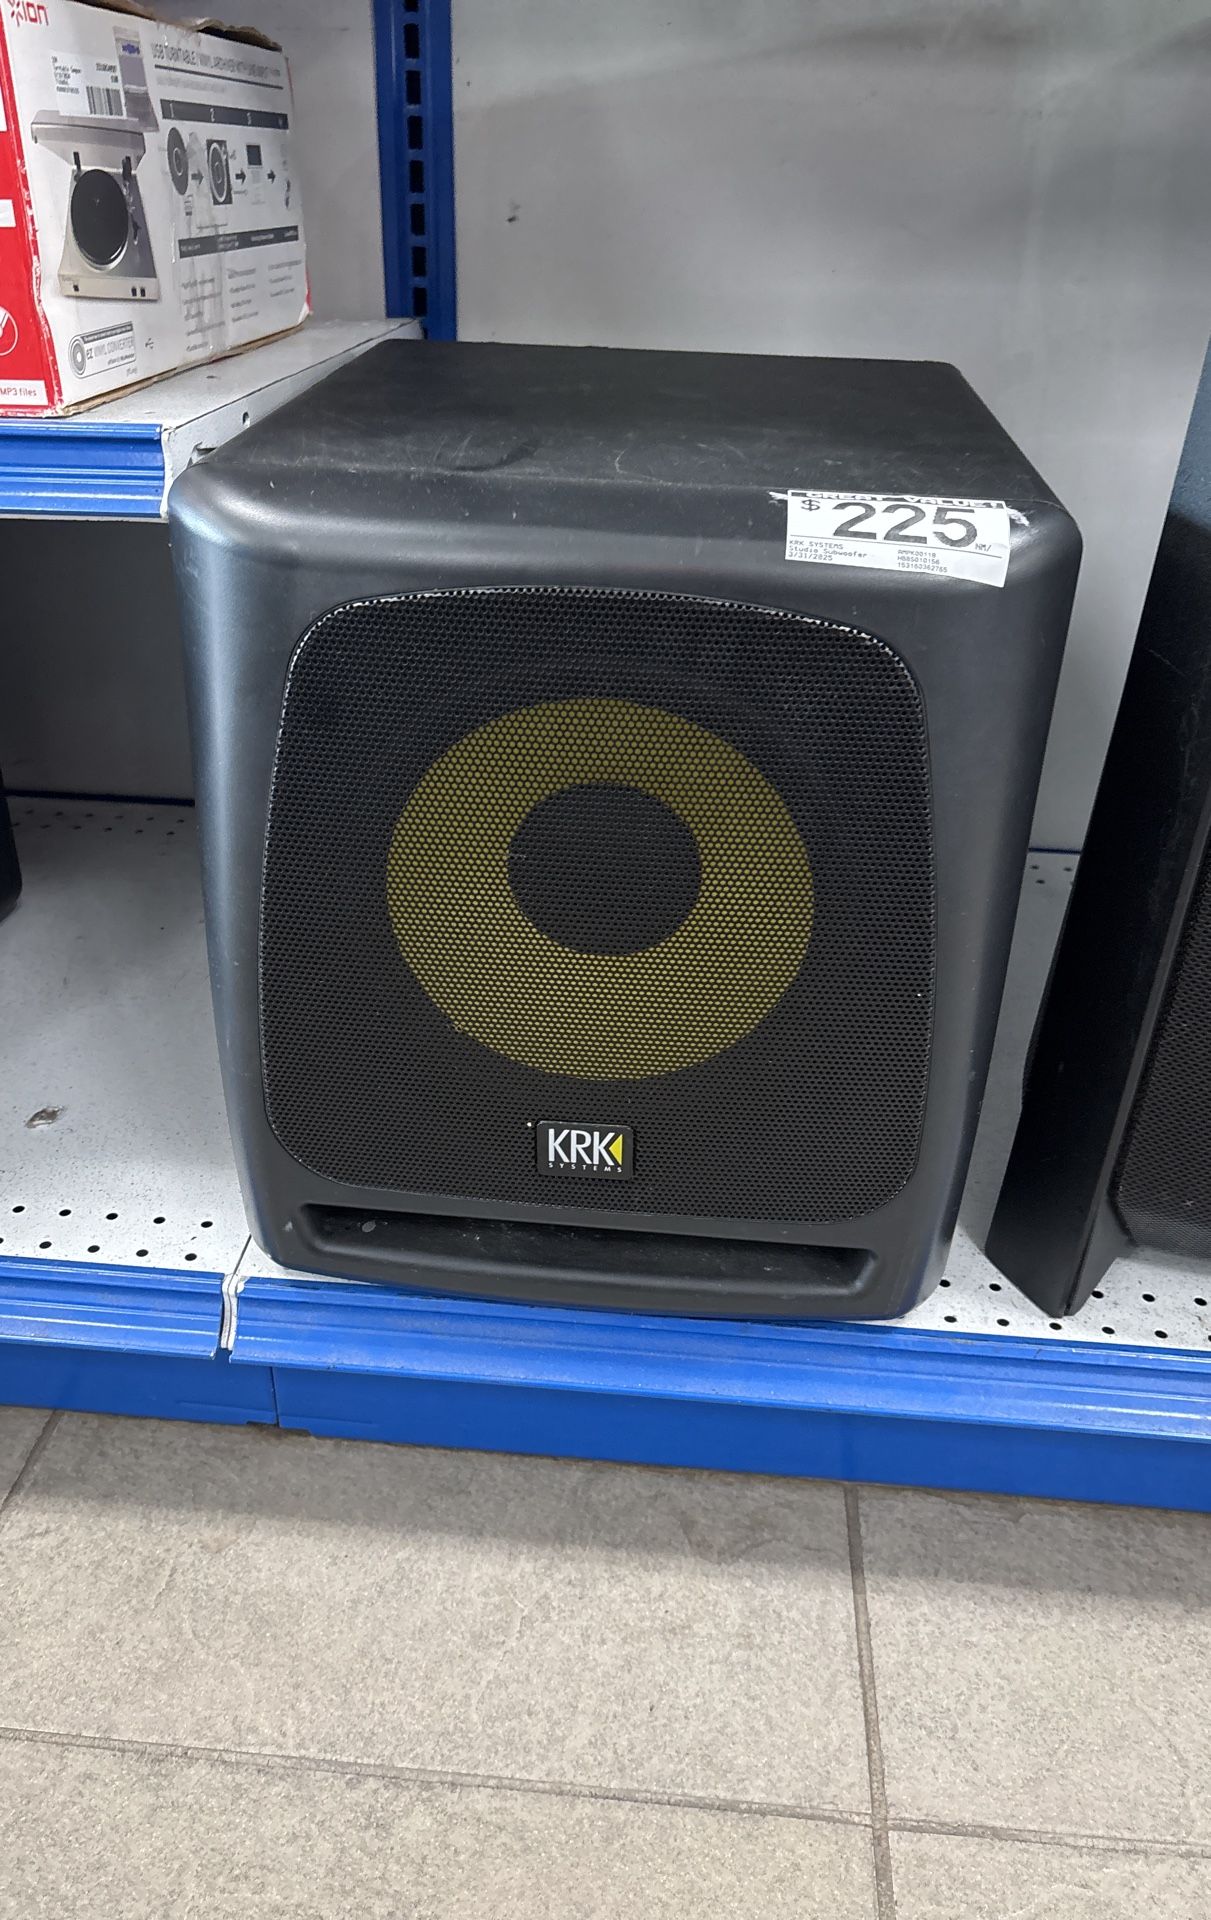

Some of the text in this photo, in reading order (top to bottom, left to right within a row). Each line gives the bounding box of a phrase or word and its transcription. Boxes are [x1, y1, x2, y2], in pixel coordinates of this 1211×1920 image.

[19, 386, 38, 397] files
[808, 541, 844, 550] SYSTEMS
[789, 545, 868, 558] Studio Subwoofer
[548, 1128, 615, 1166] KRK
[548, 1162, 622, 1173] SYSTEMS
